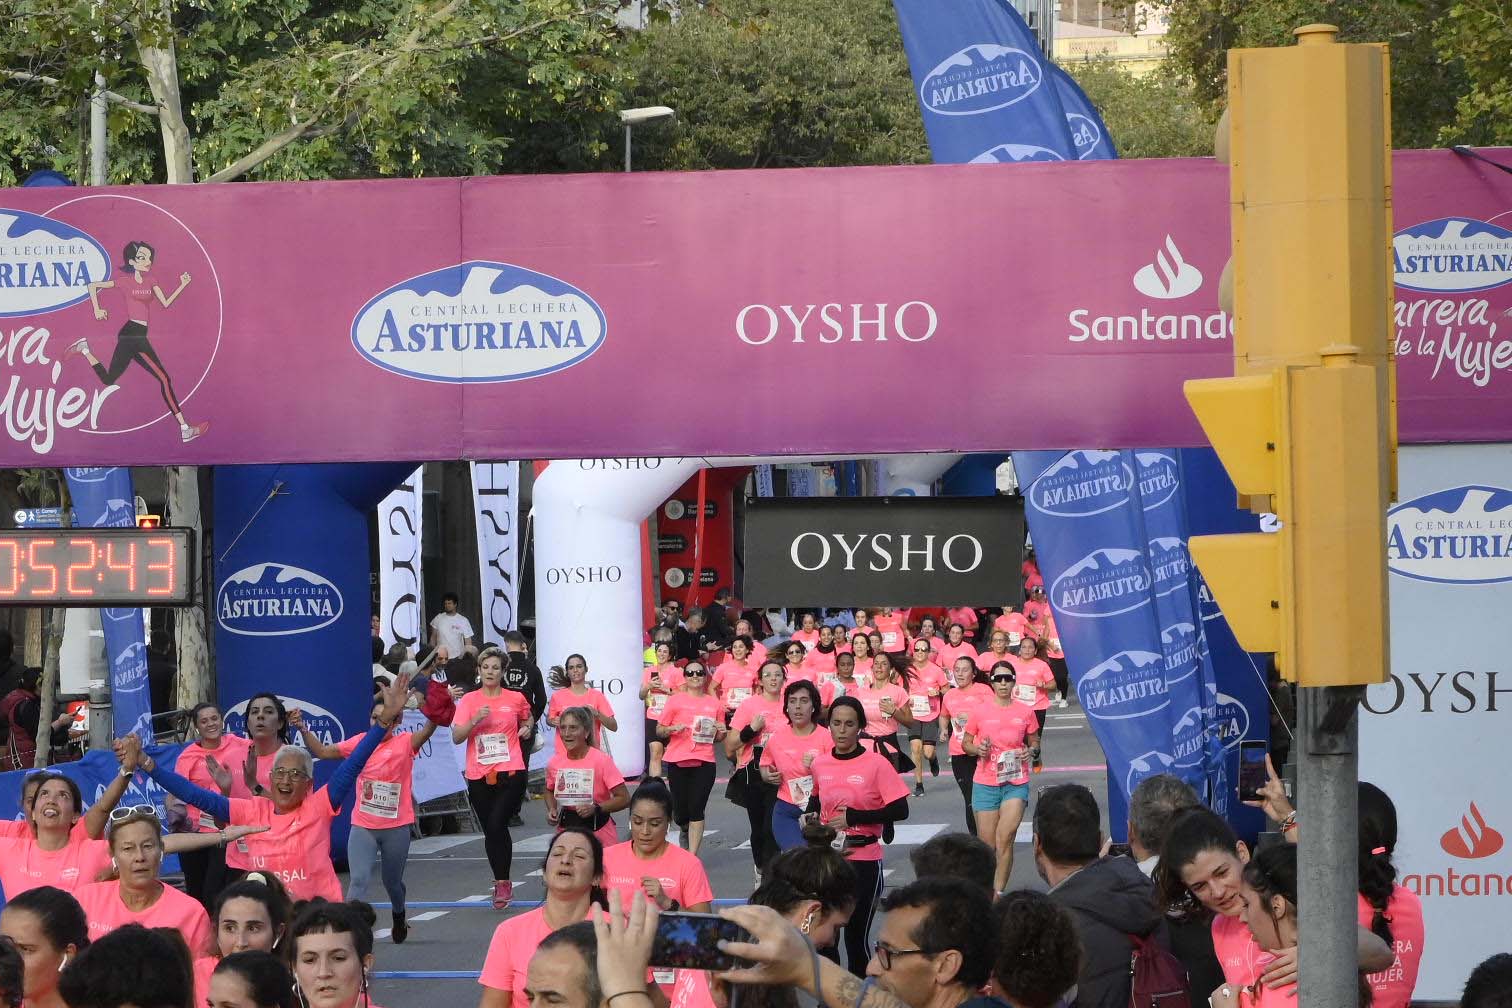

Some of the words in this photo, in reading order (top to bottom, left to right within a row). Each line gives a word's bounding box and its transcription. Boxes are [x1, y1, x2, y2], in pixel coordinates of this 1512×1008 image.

[13, 245, 86, 256] LECHERA
[411, 303, 488, 317] CENTRAL
[496, 302, 578, 315] LECHERA
[735, 300, 938, 345] OYSHO
[1393, 298, 1490, 327] arrera
[371, 309, 587, 353] ASTURIANA
[1417, 327, 1435, 356] la
[1430, 320, 1512, 387] Muje
[1415, 520, 1482, 531] CENTRAL
[790, 532, 983, 573] OYSHO
[546, 565, 622, 585] OYSHO
[233, 587, 277, 596] CENTRAL
[280, 587, 329, 596] LECHERA
[220, 592, 334, 620] ASTURIANA
